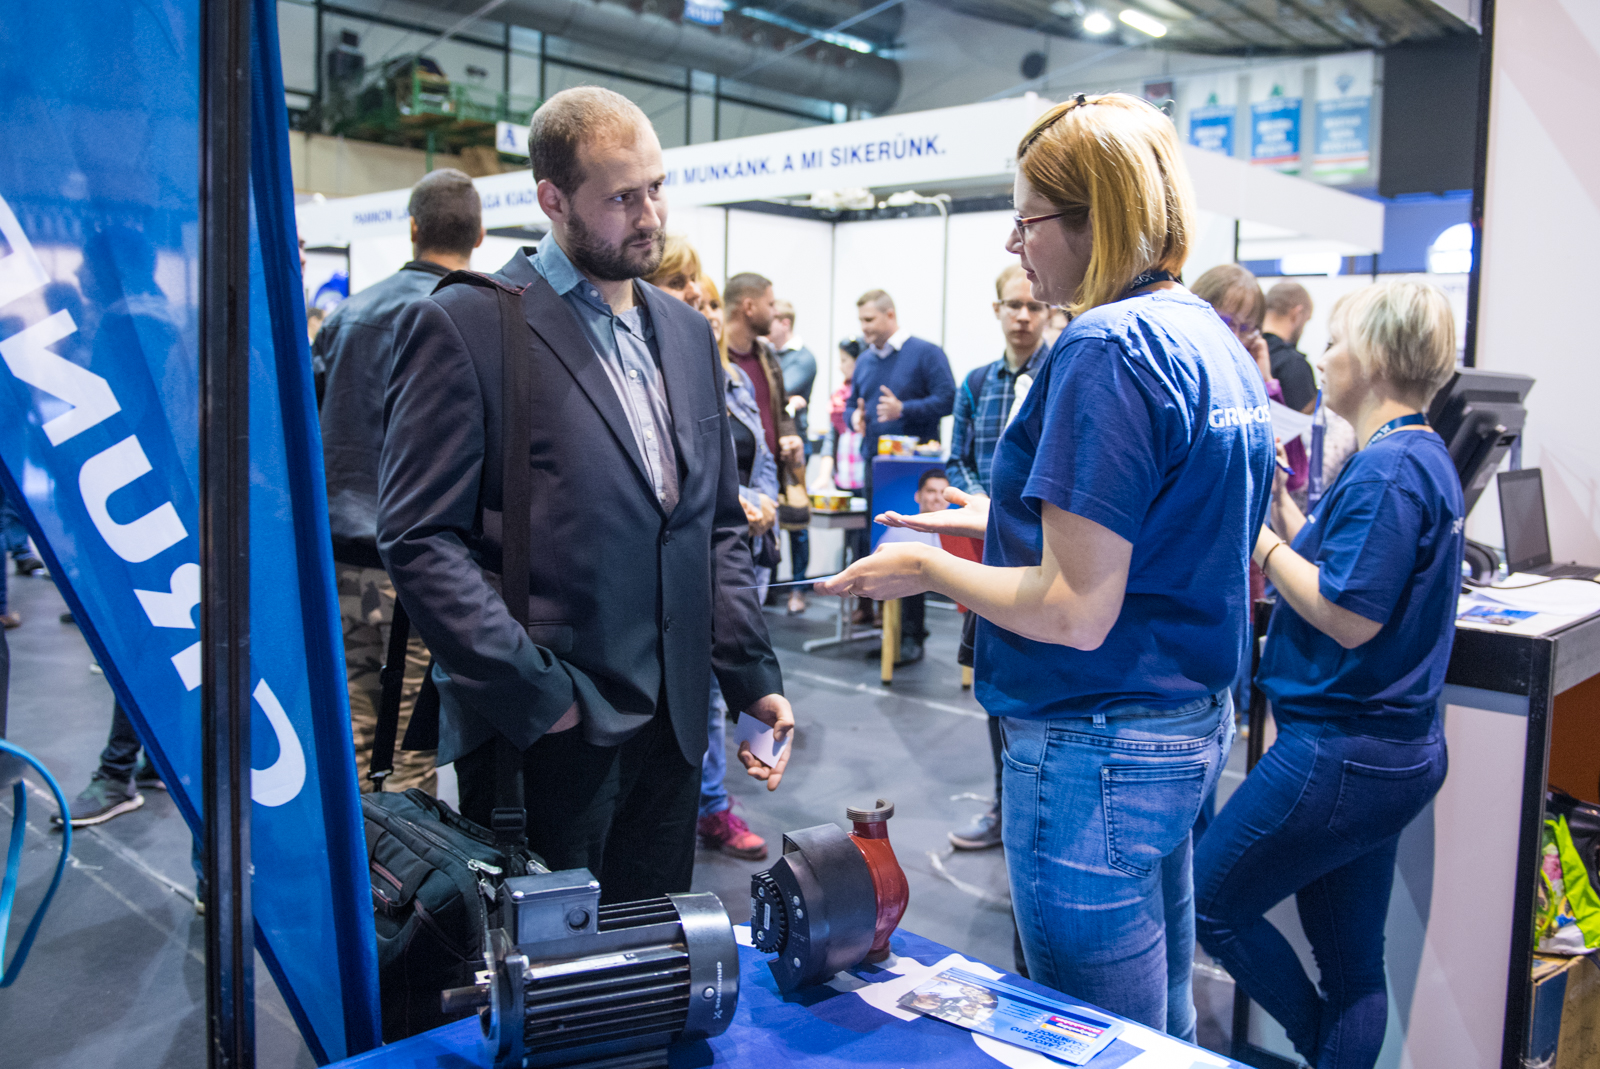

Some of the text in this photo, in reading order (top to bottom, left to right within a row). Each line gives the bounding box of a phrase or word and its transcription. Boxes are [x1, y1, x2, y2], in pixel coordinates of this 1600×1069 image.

[683, 154, 776, 184] MUNKÁNK.
[782, 155, 794, 172] A
[801, 149, 823, 170] MI
[830, 132, 946, 167] SIKERÜNK.
